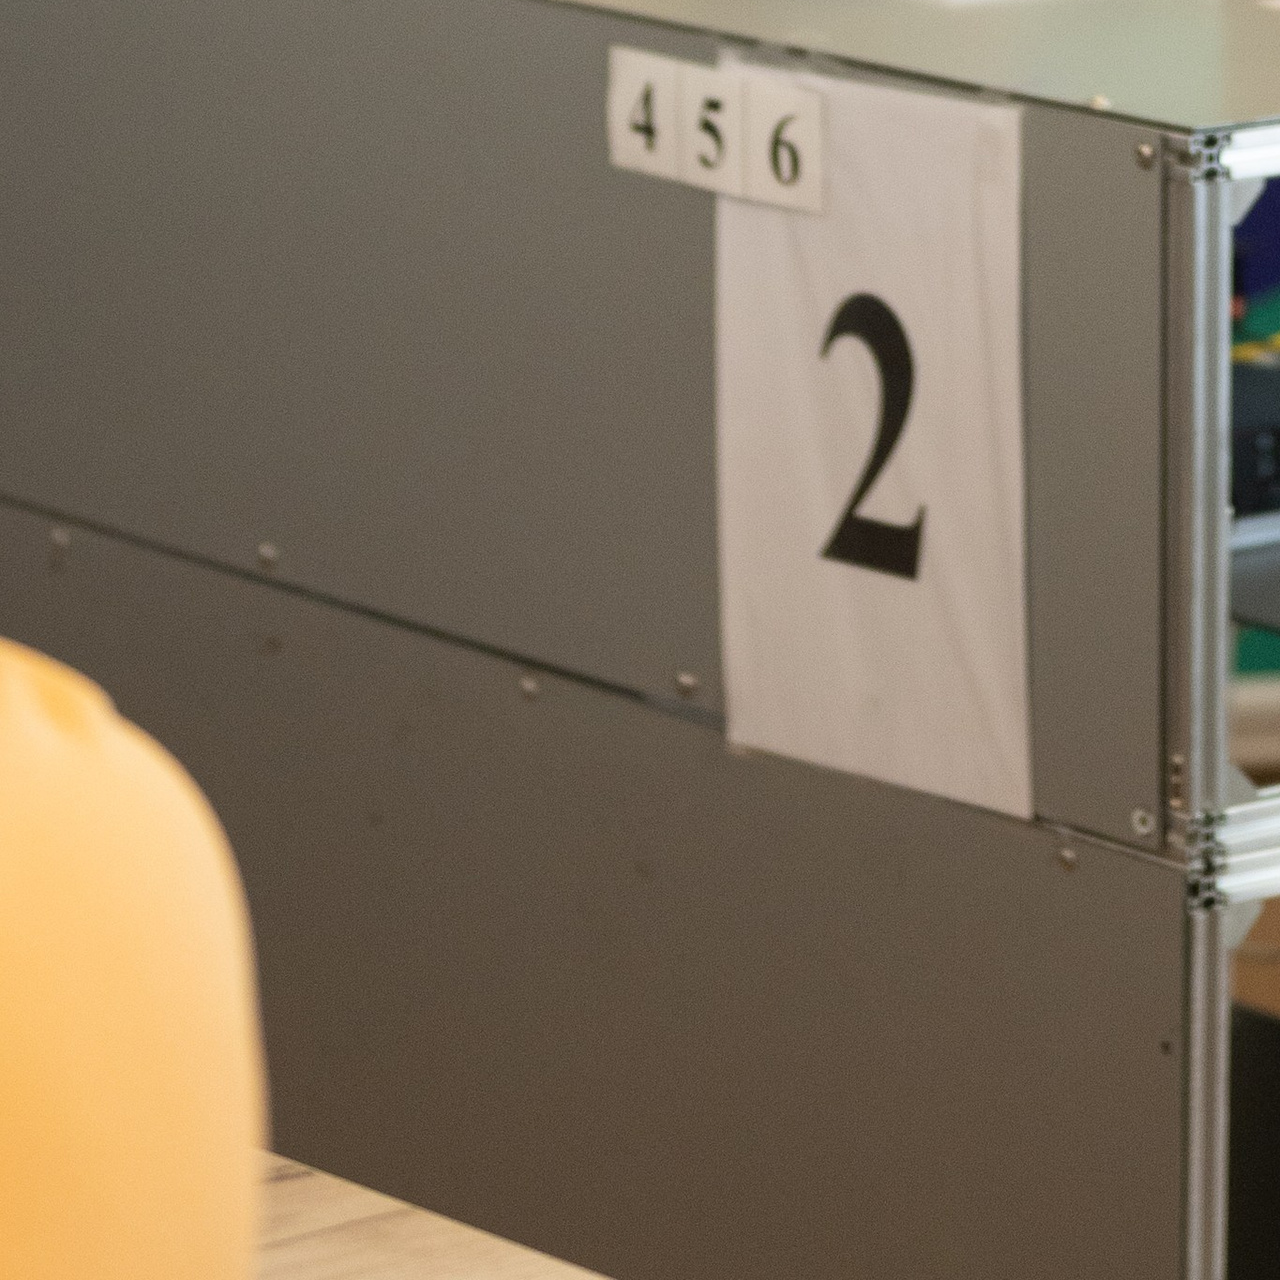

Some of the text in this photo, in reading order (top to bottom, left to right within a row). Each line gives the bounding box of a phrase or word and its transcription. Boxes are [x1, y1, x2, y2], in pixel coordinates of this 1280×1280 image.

[629, 80, 802, 187] 4 5 6
[819, 292, 926, 581] 2
